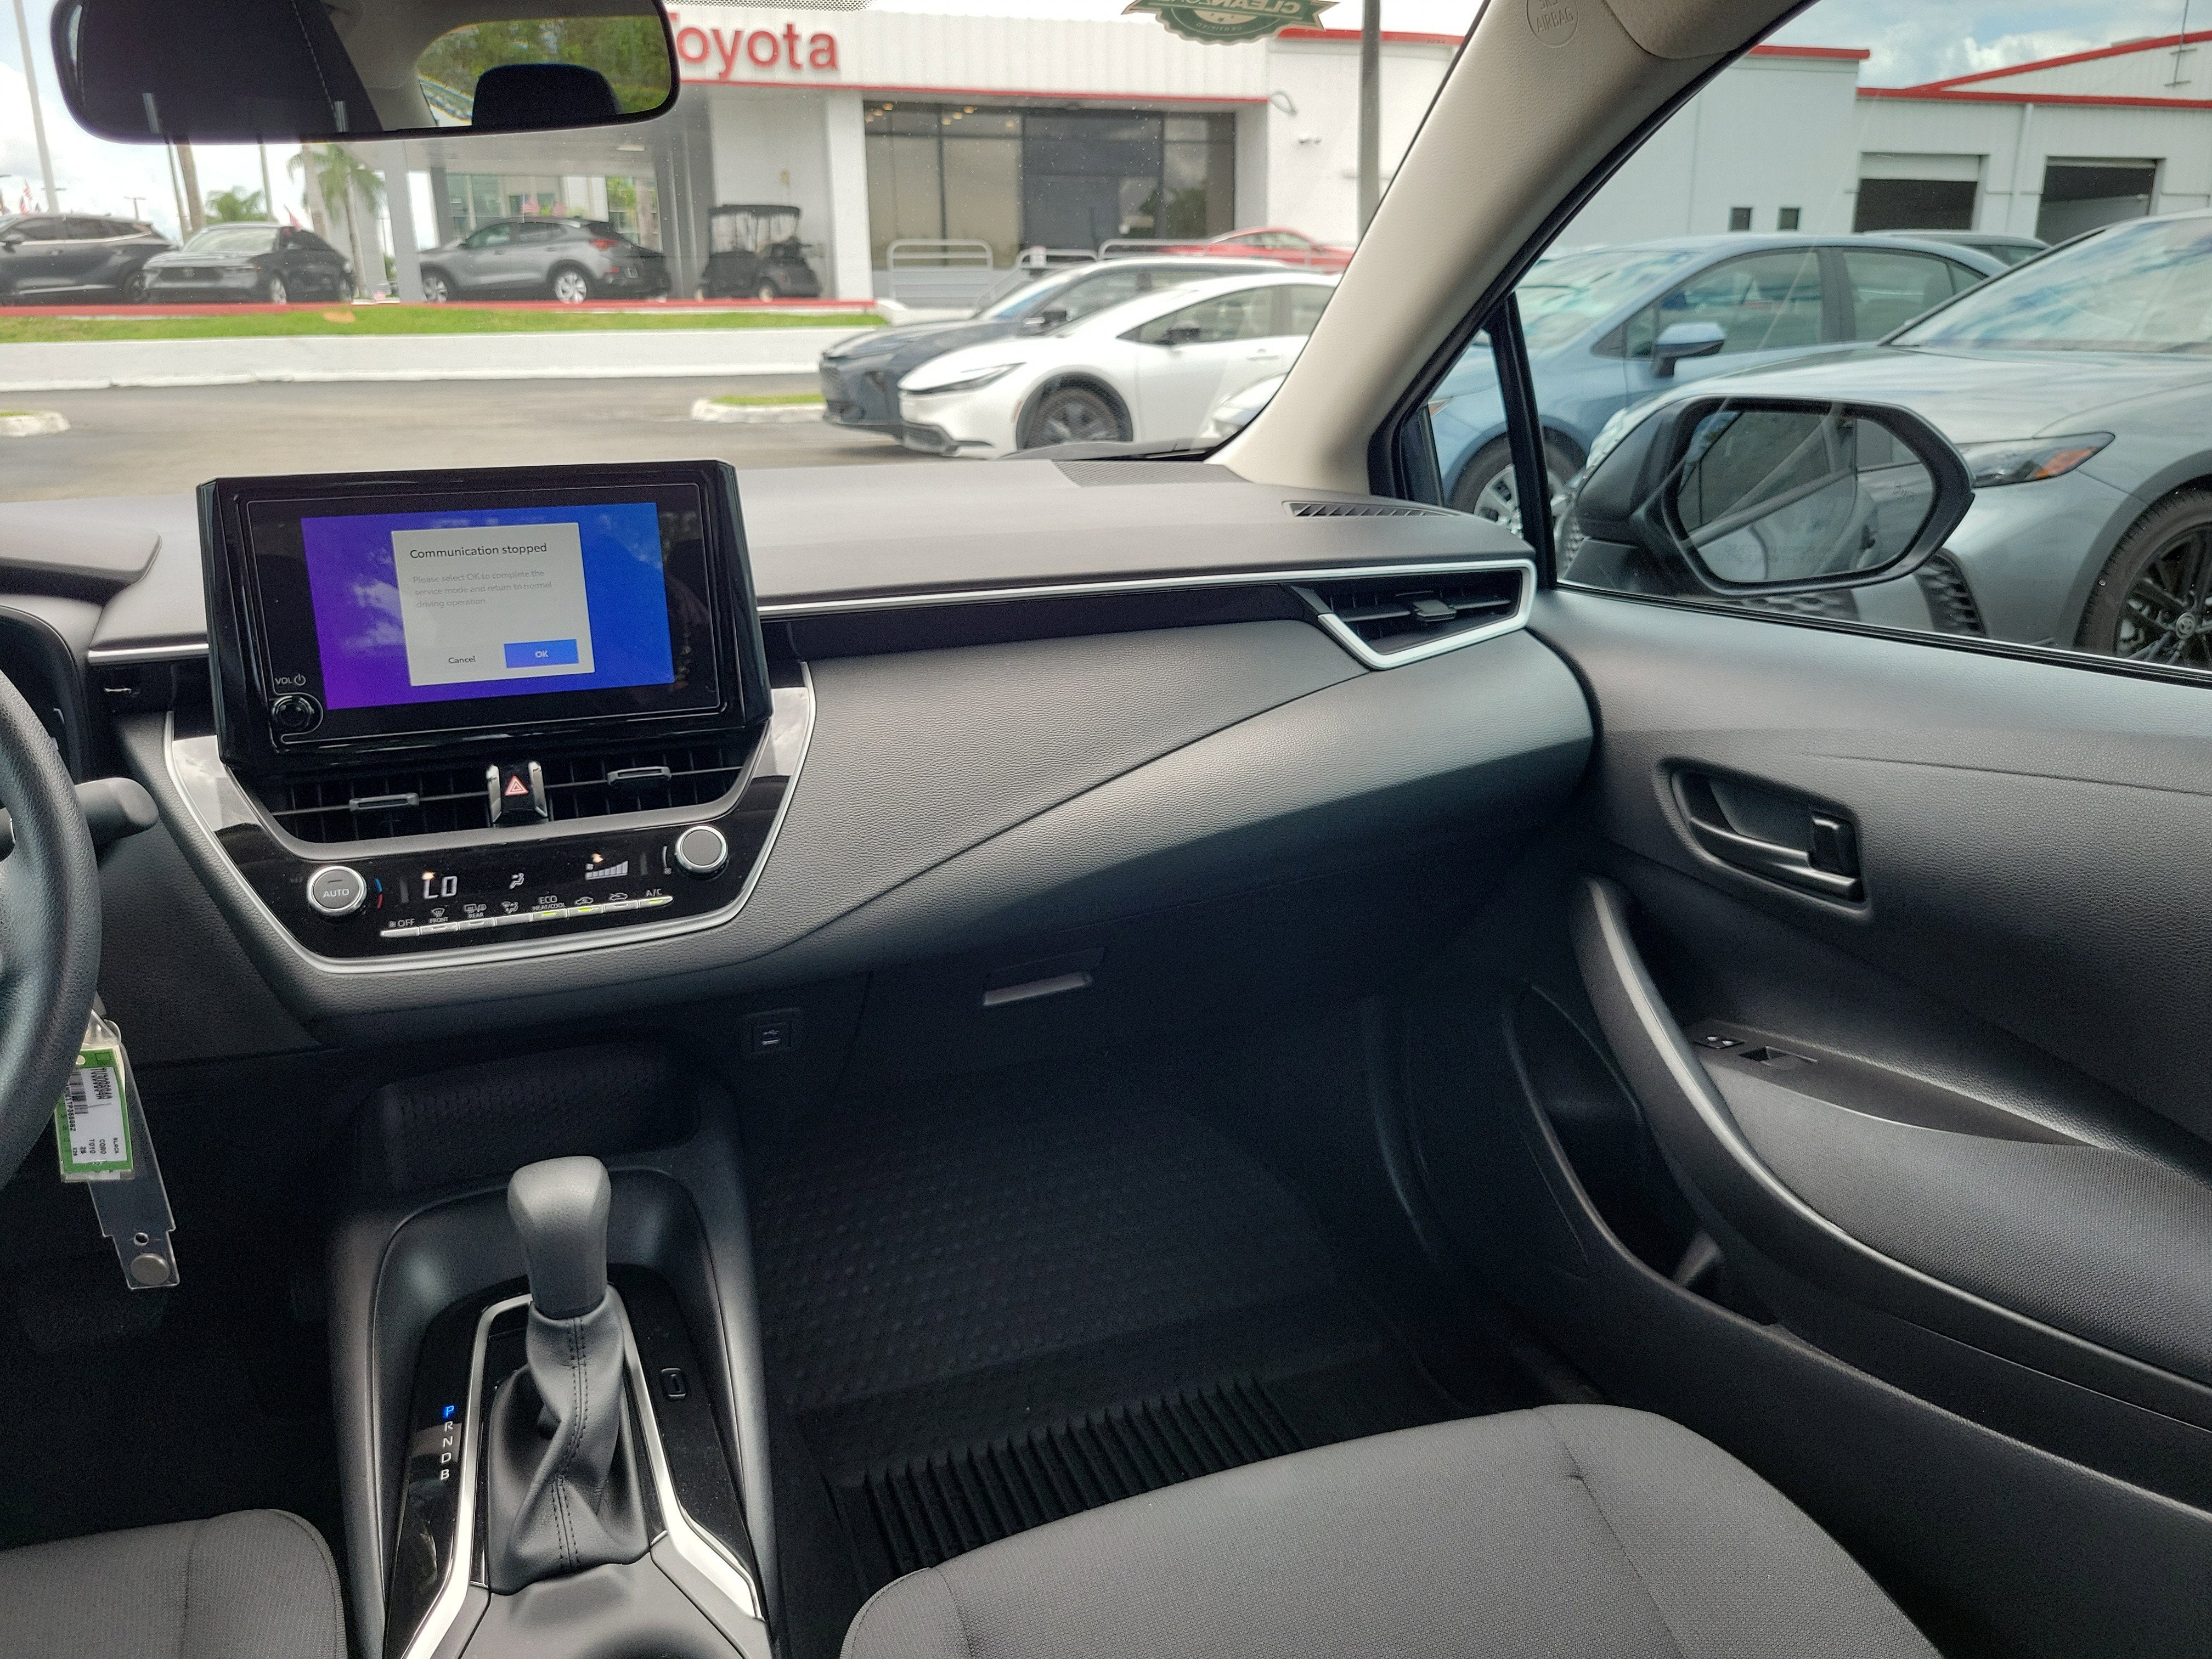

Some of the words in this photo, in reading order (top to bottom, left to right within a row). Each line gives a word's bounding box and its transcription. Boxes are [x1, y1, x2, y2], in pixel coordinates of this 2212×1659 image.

[1537, 7, 1573, 32] AIRBAG
[669, 13, 838, 81] oyota
[410, 546, 499, 558] Communication
[503, 543, 547, 555] stopped
[413, 575, 440, 584] Please
[442, 574, 465, 582] select
[492, 571, 530, 580] complete
[524, 581, 552, 590] normal
[416, 600, 444, 608] driving
[534, 650, 549, 658] OK
[448, 656, 476, 664] Cancel
[275, 676, 293, 685] VOL
[323, 888, 350, 899] AUTO
[645, 888, 663, 898] A/C
[539, 895, 558, 905] ECO
[532, 901, 566, 911] HEAT/COOL
[397, 918, 416, 927] OFF
[429, 916, 449, 924] FRONT
[445, 1404, 455, 1418] P
[444, 1420, 454, 1432] R
[443, 1435, 454, 1448] N
[441, 1452, 452, 1464] D
[441, 1469, 450, 1481] B
